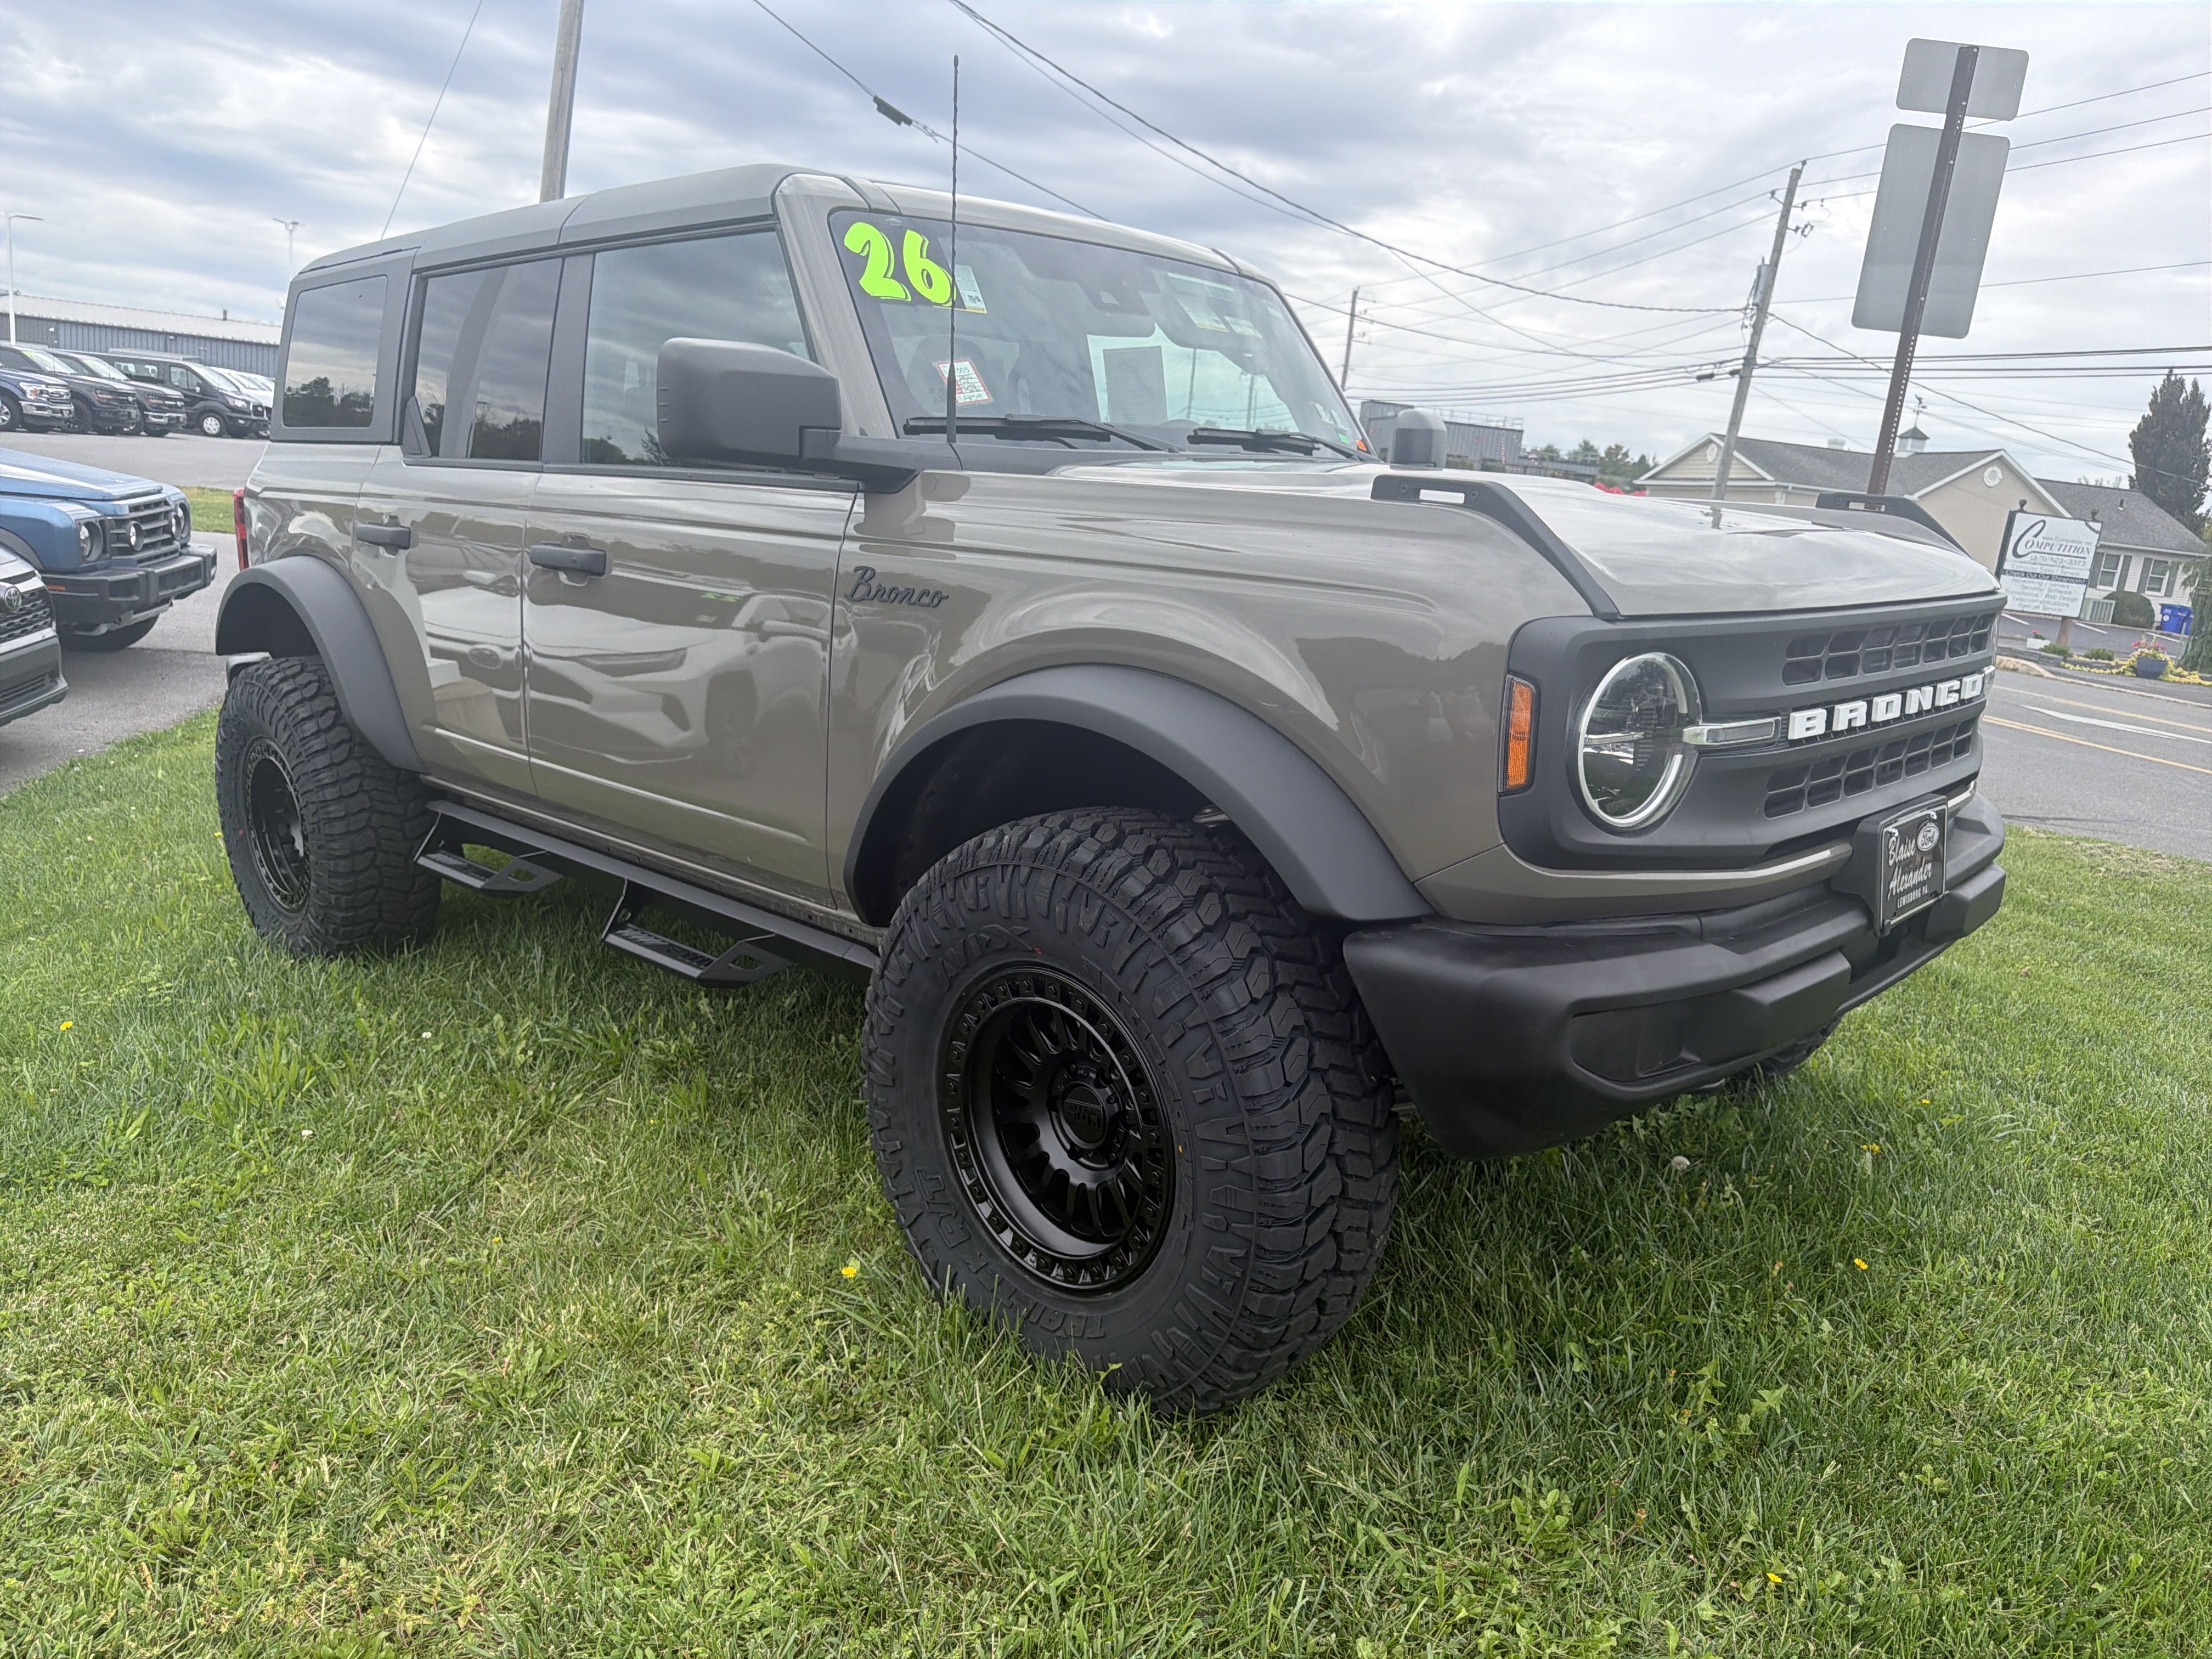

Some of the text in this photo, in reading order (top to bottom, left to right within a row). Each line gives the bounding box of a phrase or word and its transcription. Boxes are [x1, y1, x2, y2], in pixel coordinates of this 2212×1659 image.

[844, 222, 956, 307] 26
[844, 566, 950, 608] Bronco
[1788, 673, 1984, 740] BRONCO
[1888, 836, 1916, 866] Blaise
[1921, 829, 1935, 848] Ford
[1887, 856, 1932, 901] Alexander
[1897, 887, 1921, 909] LEWISBURG
